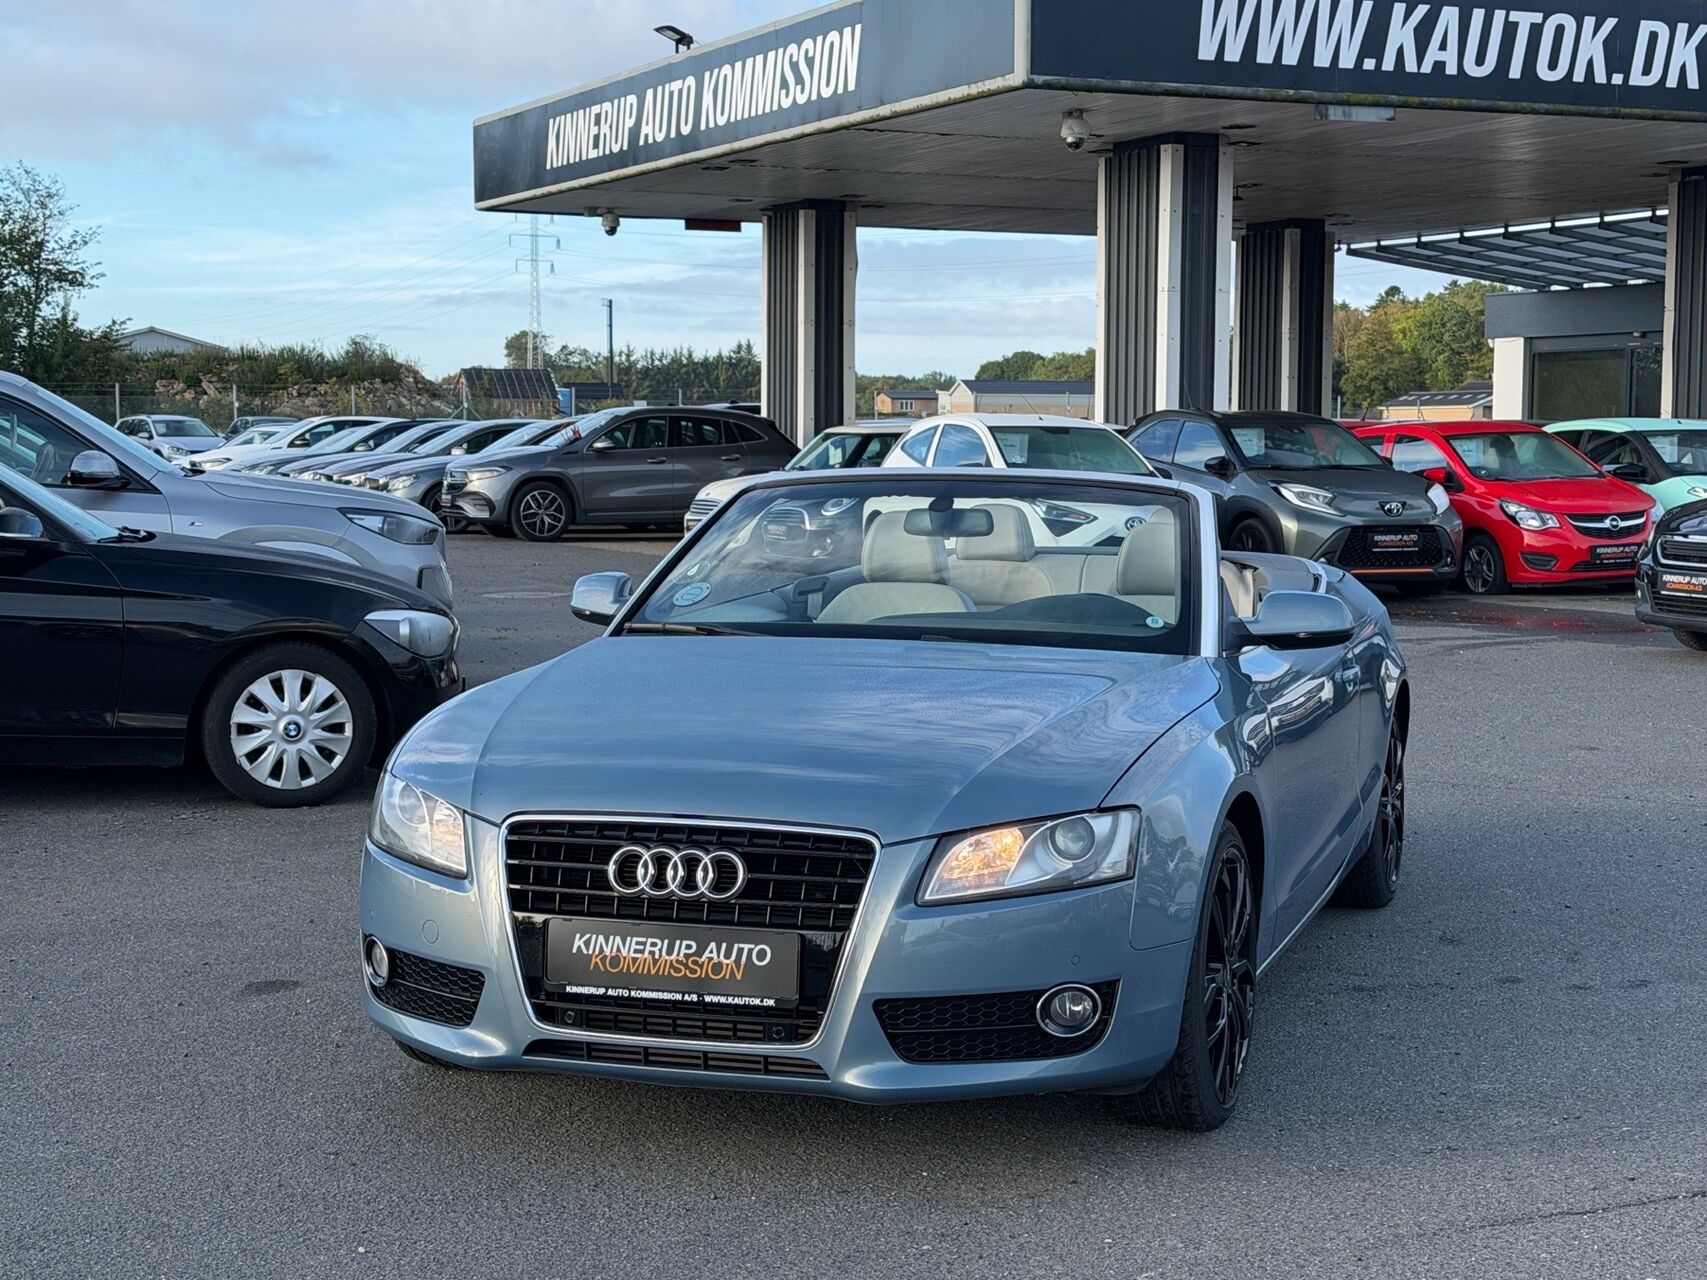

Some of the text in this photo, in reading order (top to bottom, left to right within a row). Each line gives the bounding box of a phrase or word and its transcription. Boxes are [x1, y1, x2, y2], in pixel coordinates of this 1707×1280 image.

[1198, 0, 1707, 89] WWW.KAUTOK.DK
[546, 24, 862, 169] KINNERUP AUTO KOMMISSION
[1662, 574, 1707, 585] KINNERUP AUTO
[572, 933, 772, 967] KINNERUP AUTO
[589, 952, 746, 980] KOMMISSION
[566, 986, 606, 995] KINNERUP
[607, 988, 629, 997] AUTO
[630, 990, 683, 1000] KOMMISSION
[684, 993, 698, 1001] A/S
[704, 994, 775, 1006] WWW.KAUTOK.DK
